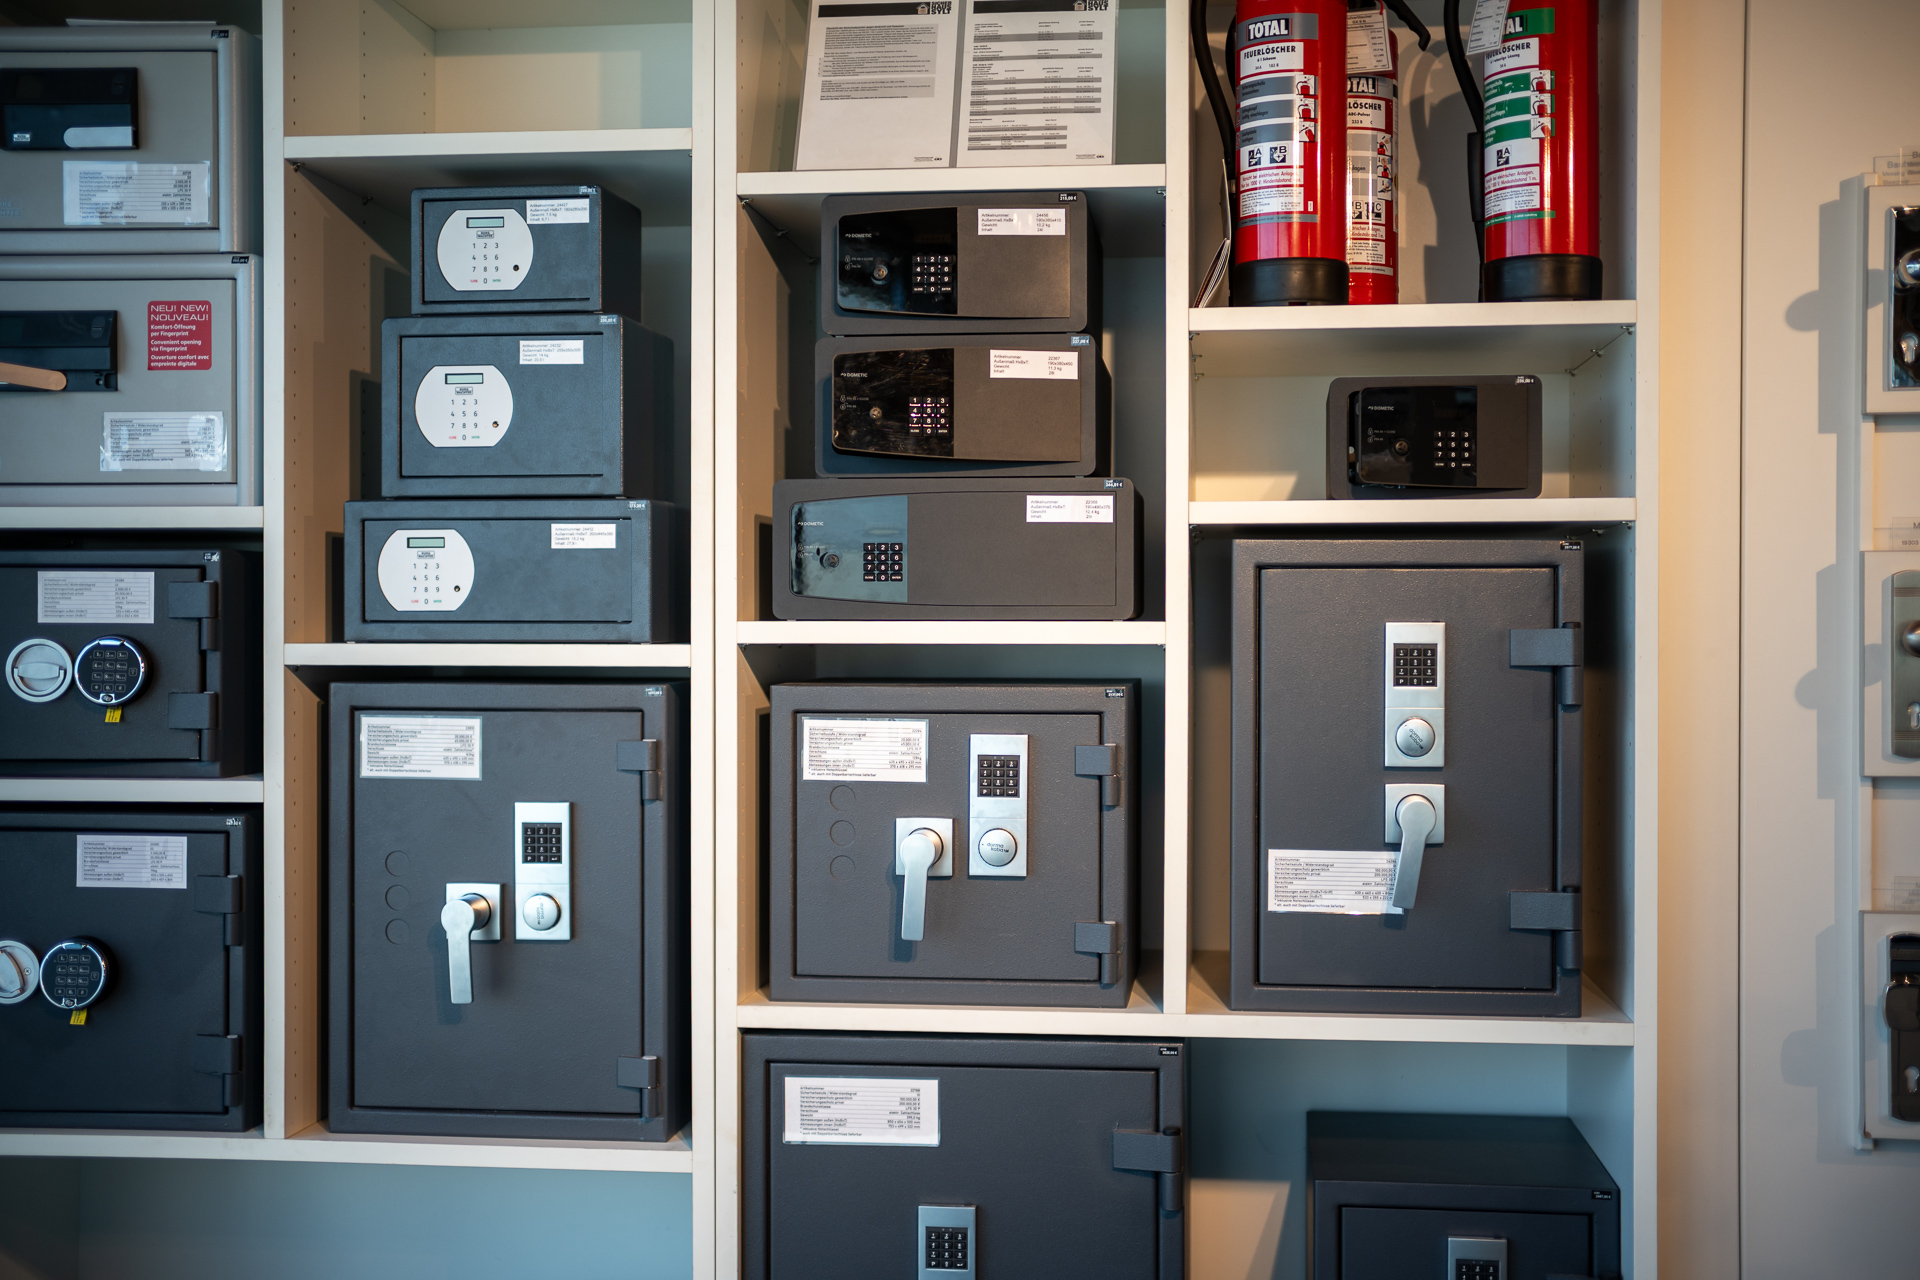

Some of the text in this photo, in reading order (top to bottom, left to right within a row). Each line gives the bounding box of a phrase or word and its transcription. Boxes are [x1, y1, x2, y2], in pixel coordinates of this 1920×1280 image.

[1248, 19, 1288, 39] TOTAL
[1244, 45, 1296, 59] FEUERLÖSCHER
[1347, 77, 1375, 93] TAL
[1348, 100, 1382, 111] LÖSCHER
[1255, 148, 1262, 156] A
[1504, 147, 1510, 155] A
[1376, 203, 1381, 211] C
[180, 304, 208, 312] NEW!
